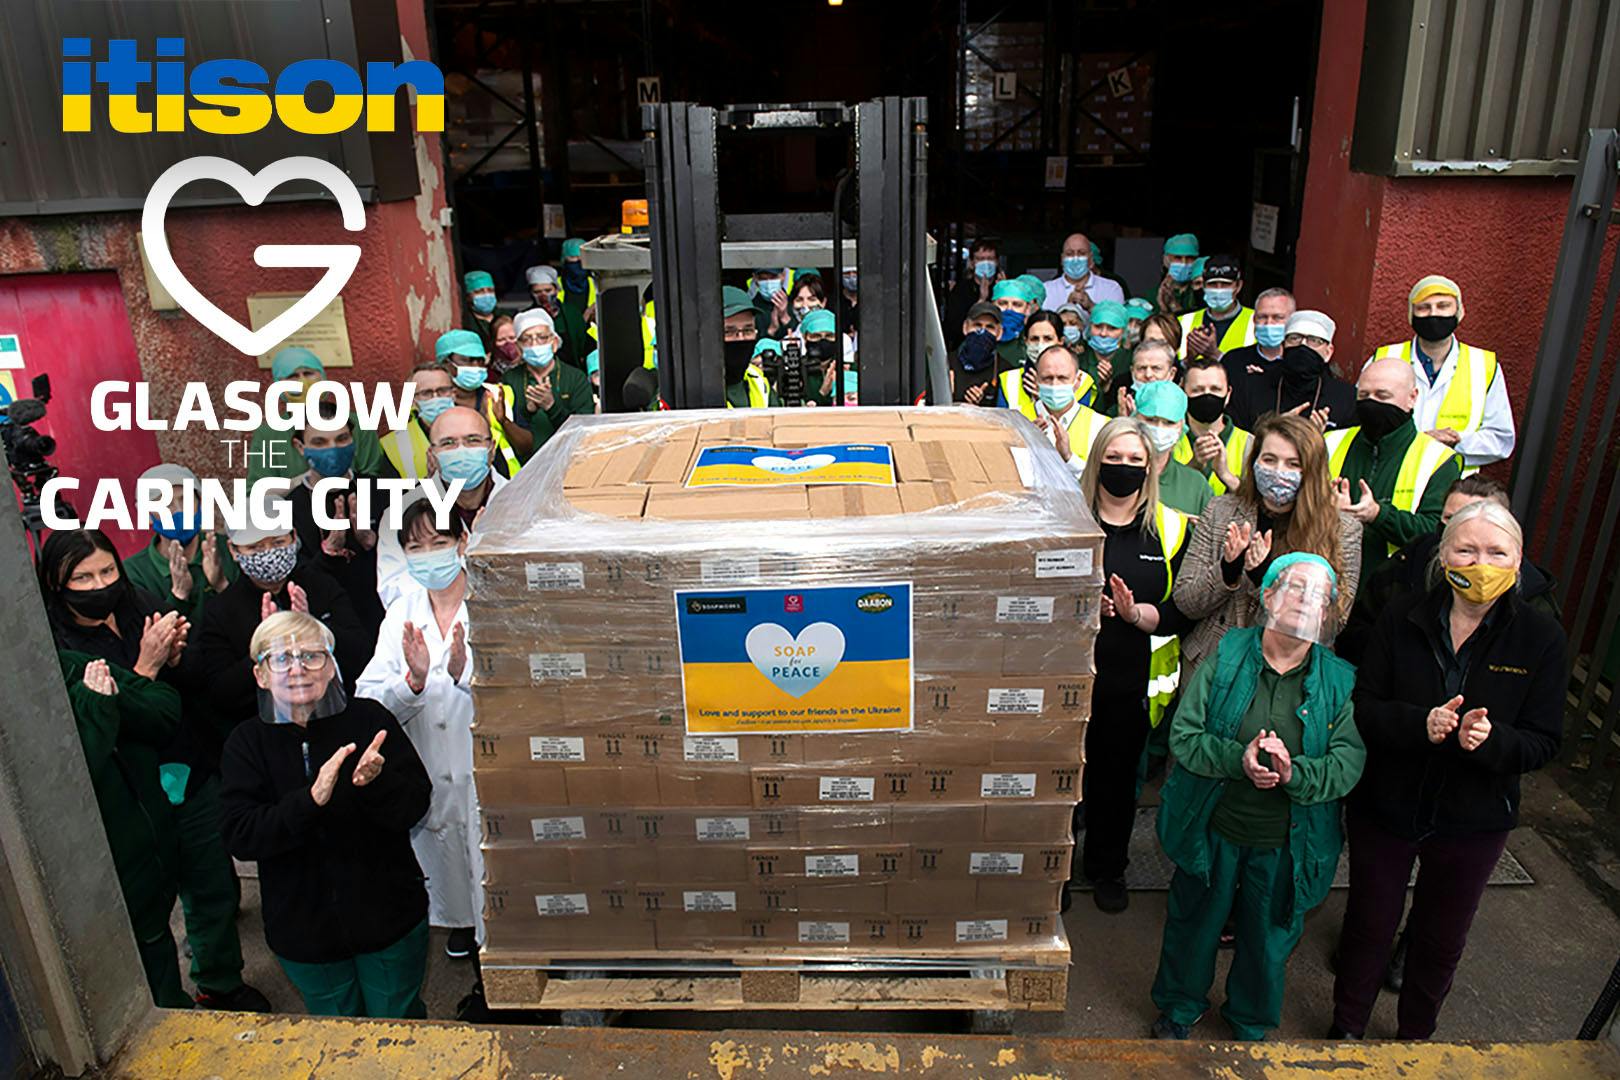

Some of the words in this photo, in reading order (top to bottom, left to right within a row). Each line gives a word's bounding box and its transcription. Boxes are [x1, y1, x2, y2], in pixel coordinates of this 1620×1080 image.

[1000, 77, 1011, 95] L
[1111, 73, 1129, 94] K
[640, 82, 659, 103] M
[857, 598, 892, 608] DAABON
[774, 646, 817, 657] SOAP
[789, 656, 802, 667] for
[772, 666, 820, 678] PEACE
[699, 708, 720, 717] Love
[723, 708, 740, 717] and
[742, 709, 776, 719] support
[778, 709, 788, 717] to
[790, 708, 805, 716] our
[808, 707, 838, 716] friends
[840, 707, 849, 715] in
[851, 706, 865, 715] the
[867, 705, 902, 715] Ukraine
